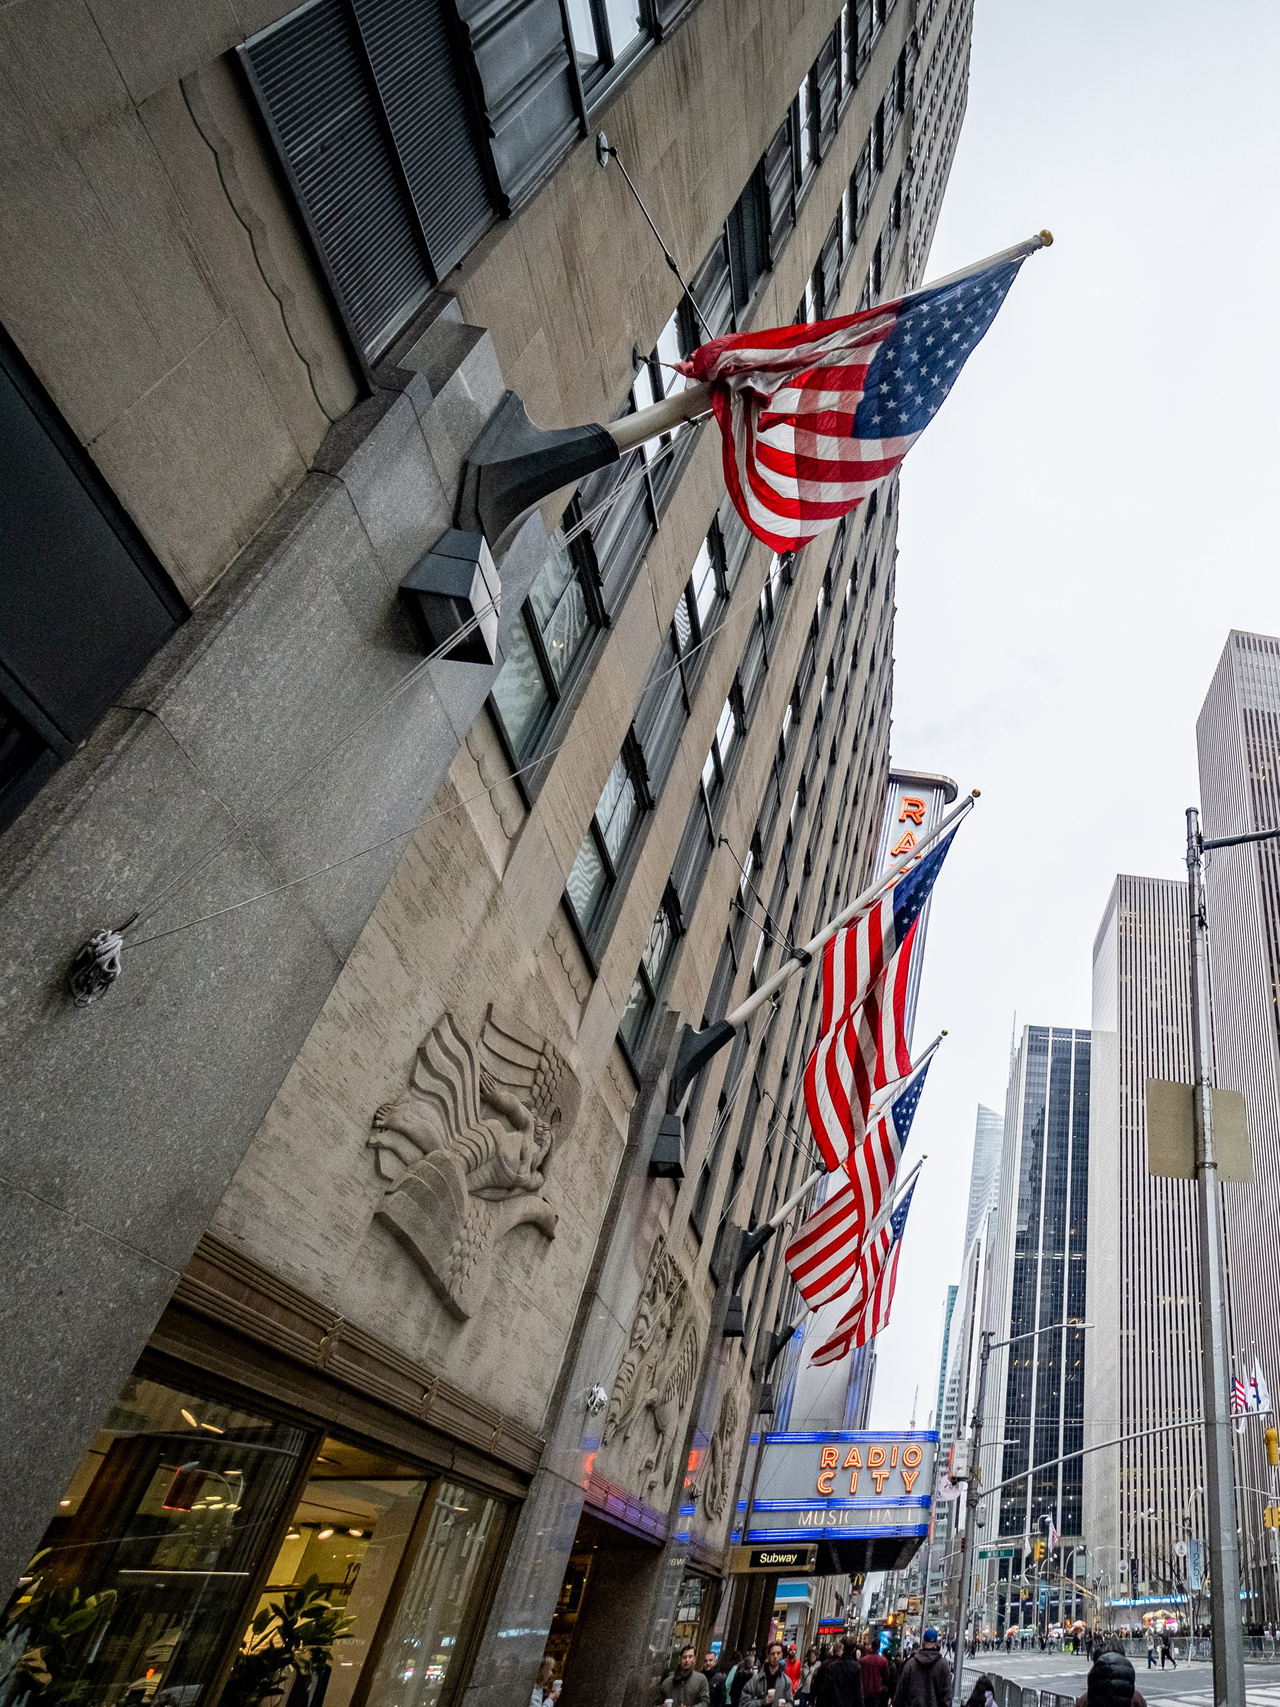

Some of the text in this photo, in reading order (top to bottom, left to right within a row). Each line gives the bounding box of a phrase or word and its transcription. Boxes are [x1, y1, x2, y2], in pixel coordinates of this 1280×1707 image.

[890, 796, 927, 870] RA
[820, 1445, 923, 1469] RADIO
[816, 1469, 920, 1495] CITY
[798, 1508, 916, 1526] MUSIC HAL
[759, 1552, 798, 1564] Subway
